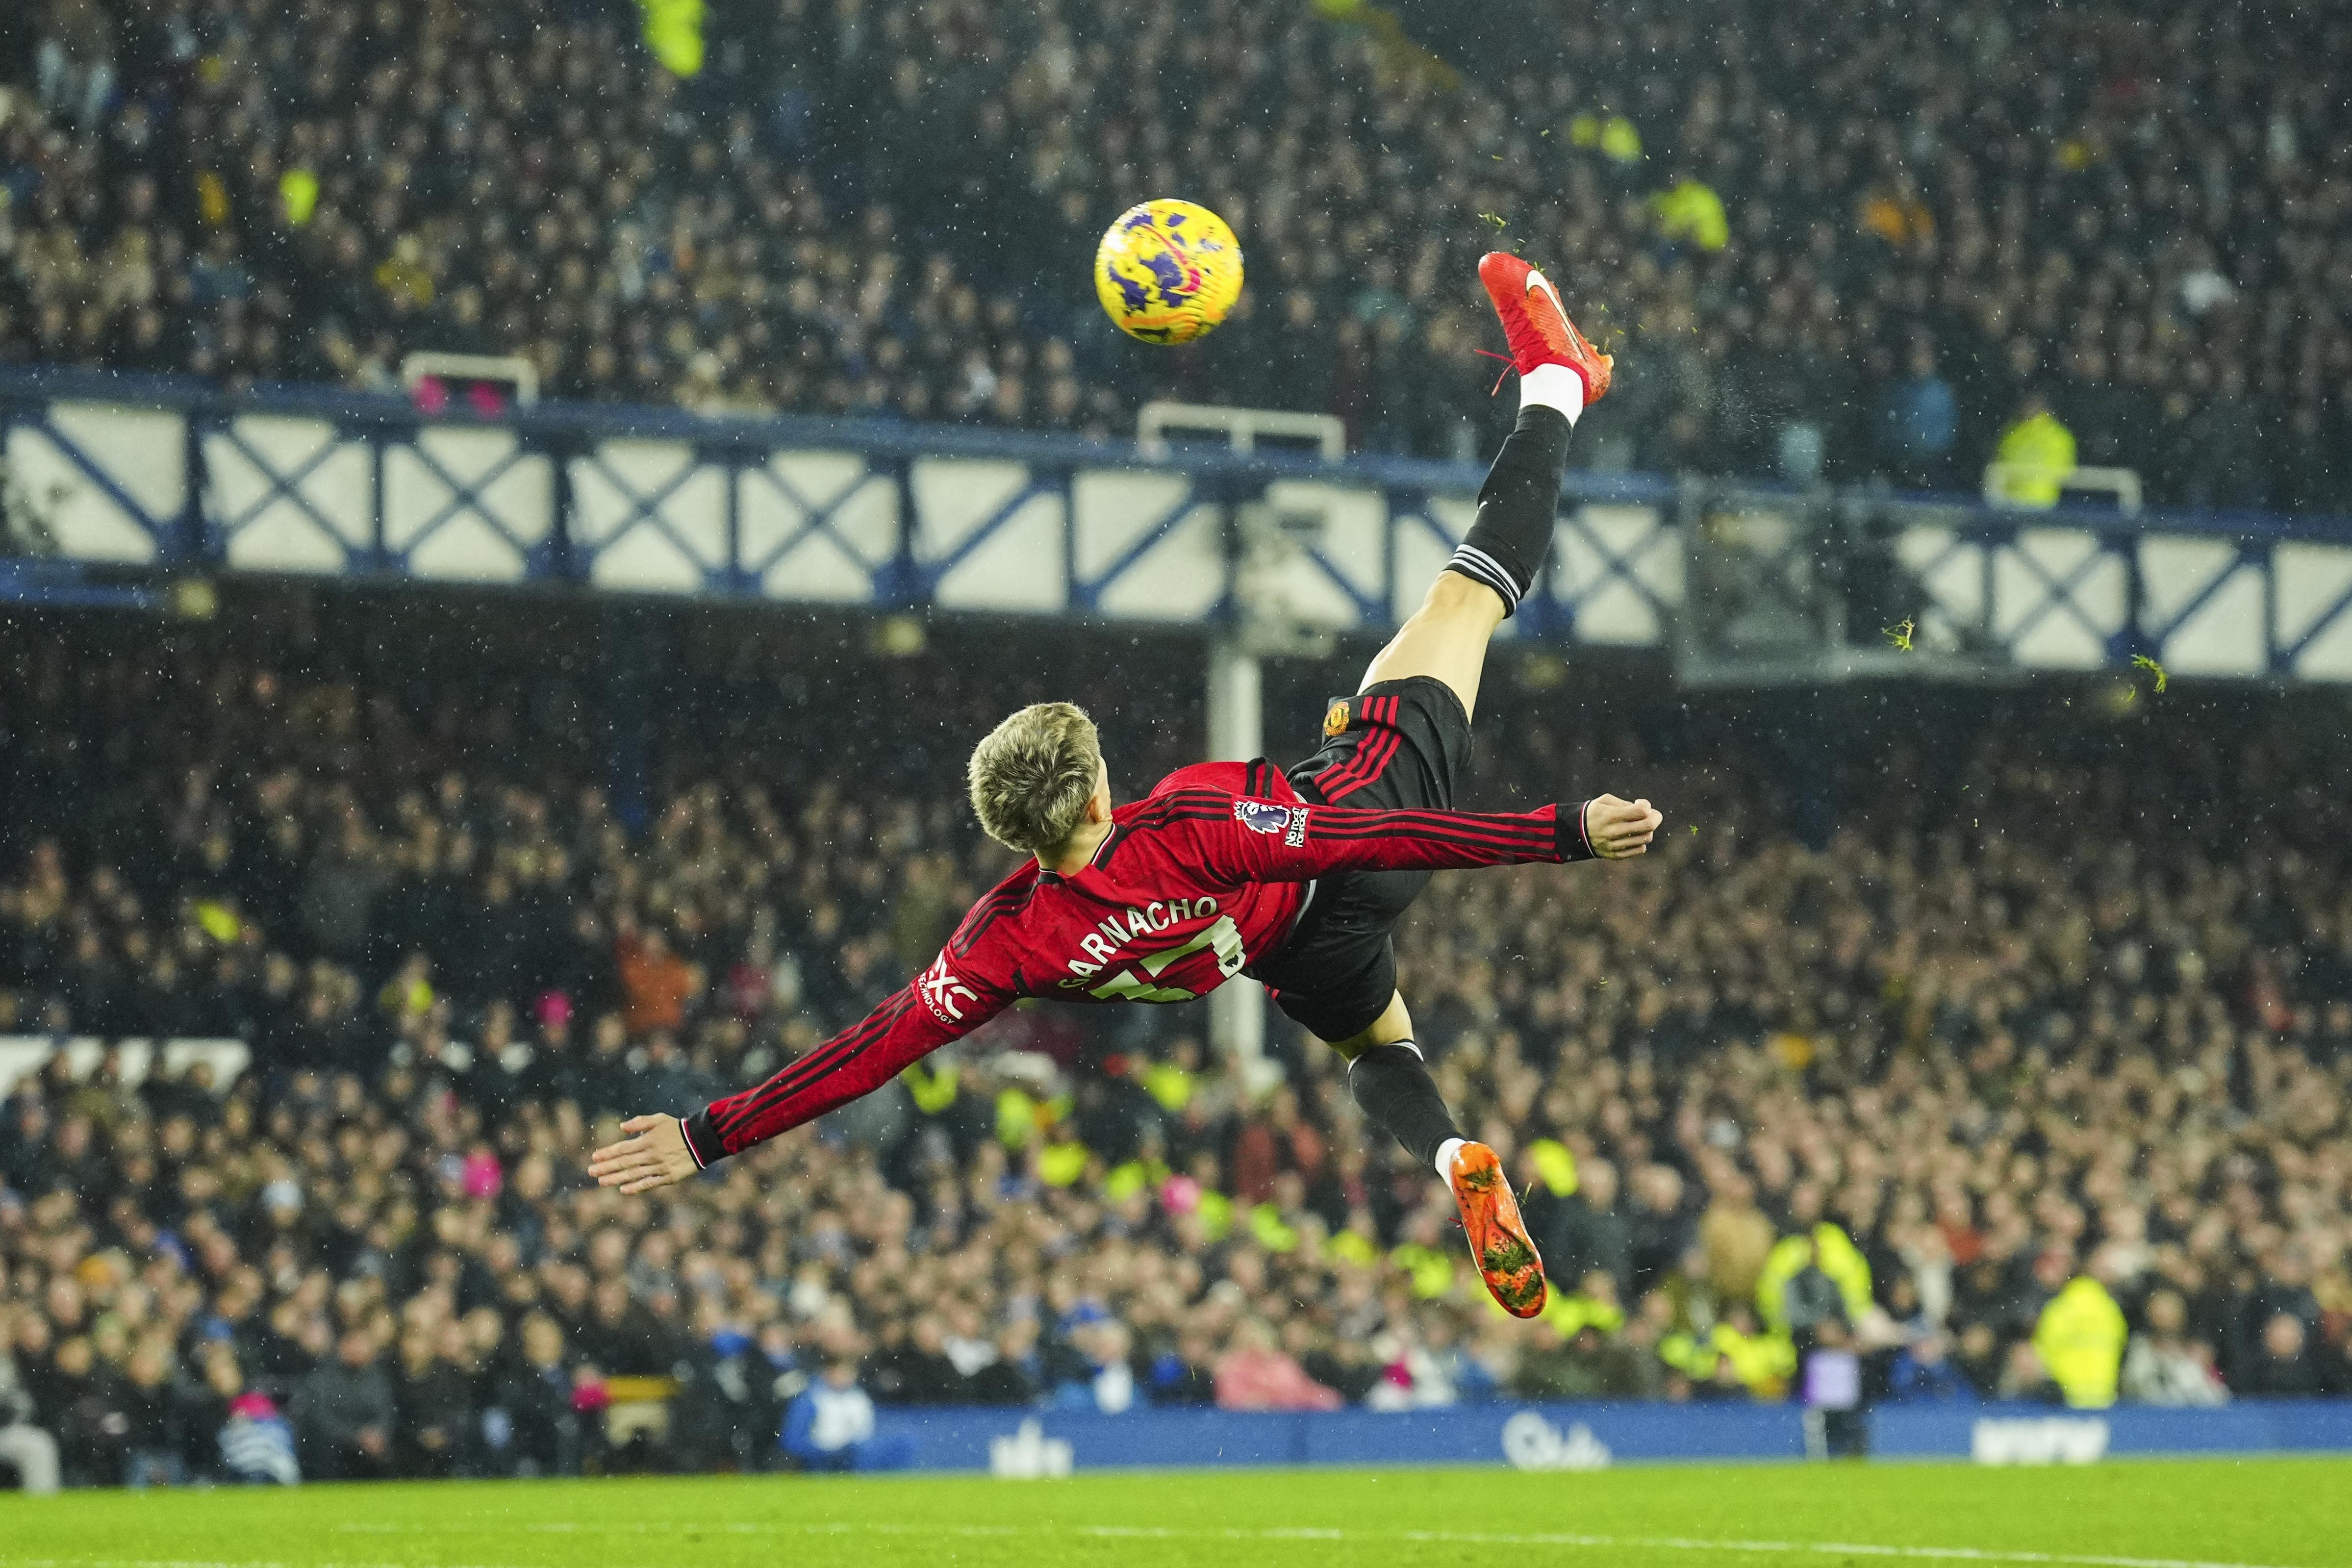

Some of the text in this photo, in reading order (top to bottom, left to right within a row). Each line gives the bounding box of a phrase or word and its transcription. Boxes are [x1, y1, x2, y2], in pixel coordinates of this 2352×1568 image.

[1285, 831, 1297, 846] No
[1294, 833, 1304, 848] for
[1058, 896, 1217, 988] GARNACHO
